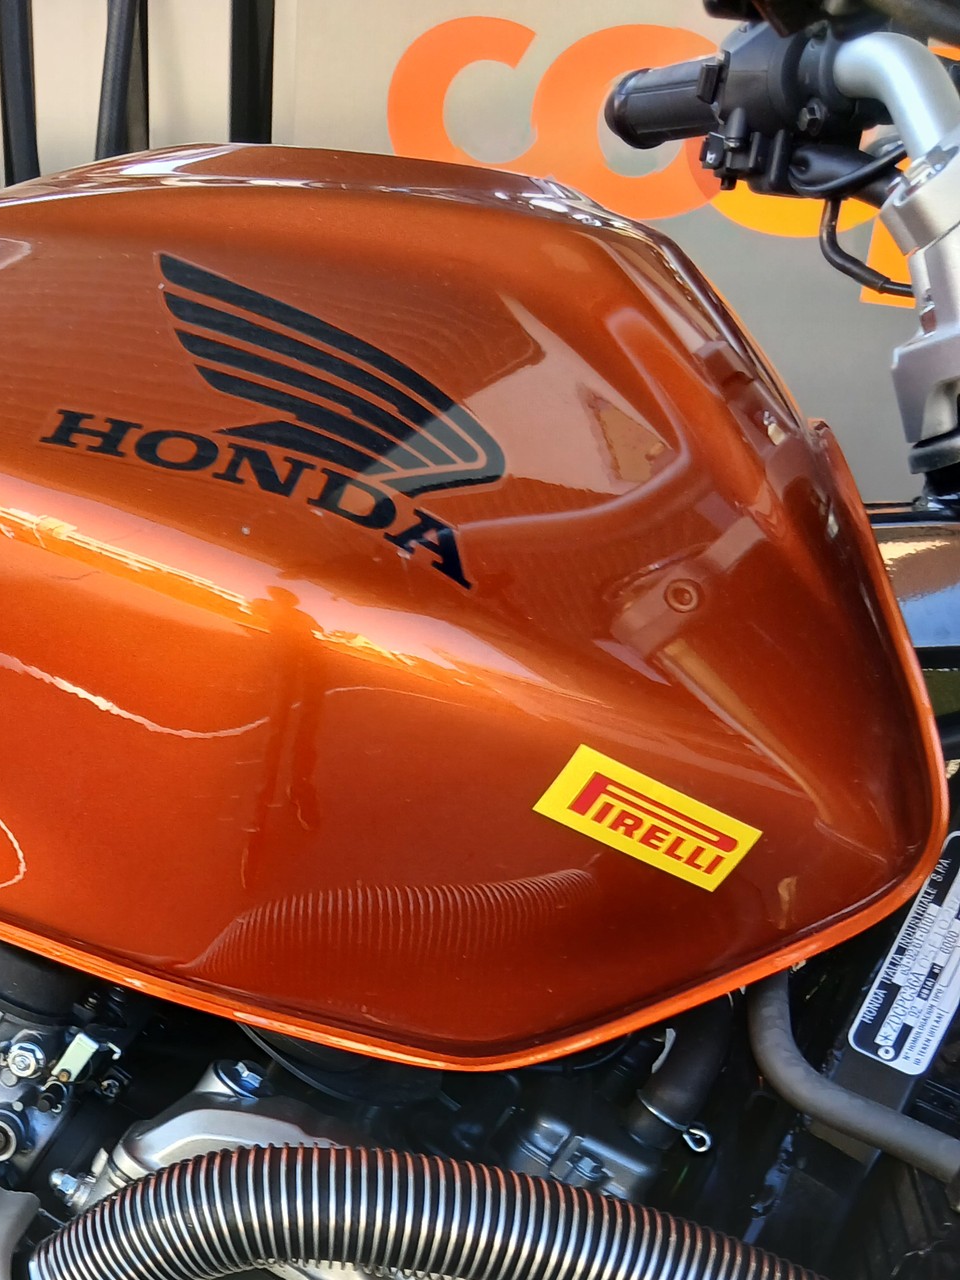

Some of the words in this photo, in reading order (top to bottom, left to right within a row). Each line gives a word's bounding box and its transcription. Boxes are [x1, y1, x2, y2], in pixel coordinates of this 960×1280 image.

[40, 408, 472, 591] HONDA
[567, 771, 739, 875] PIRELLI
[860, 987, 887, 1024] HONDA
[880, 953, 904, 983] ITALIA
[898, 885, 937, 948] INDUSTRIALE
